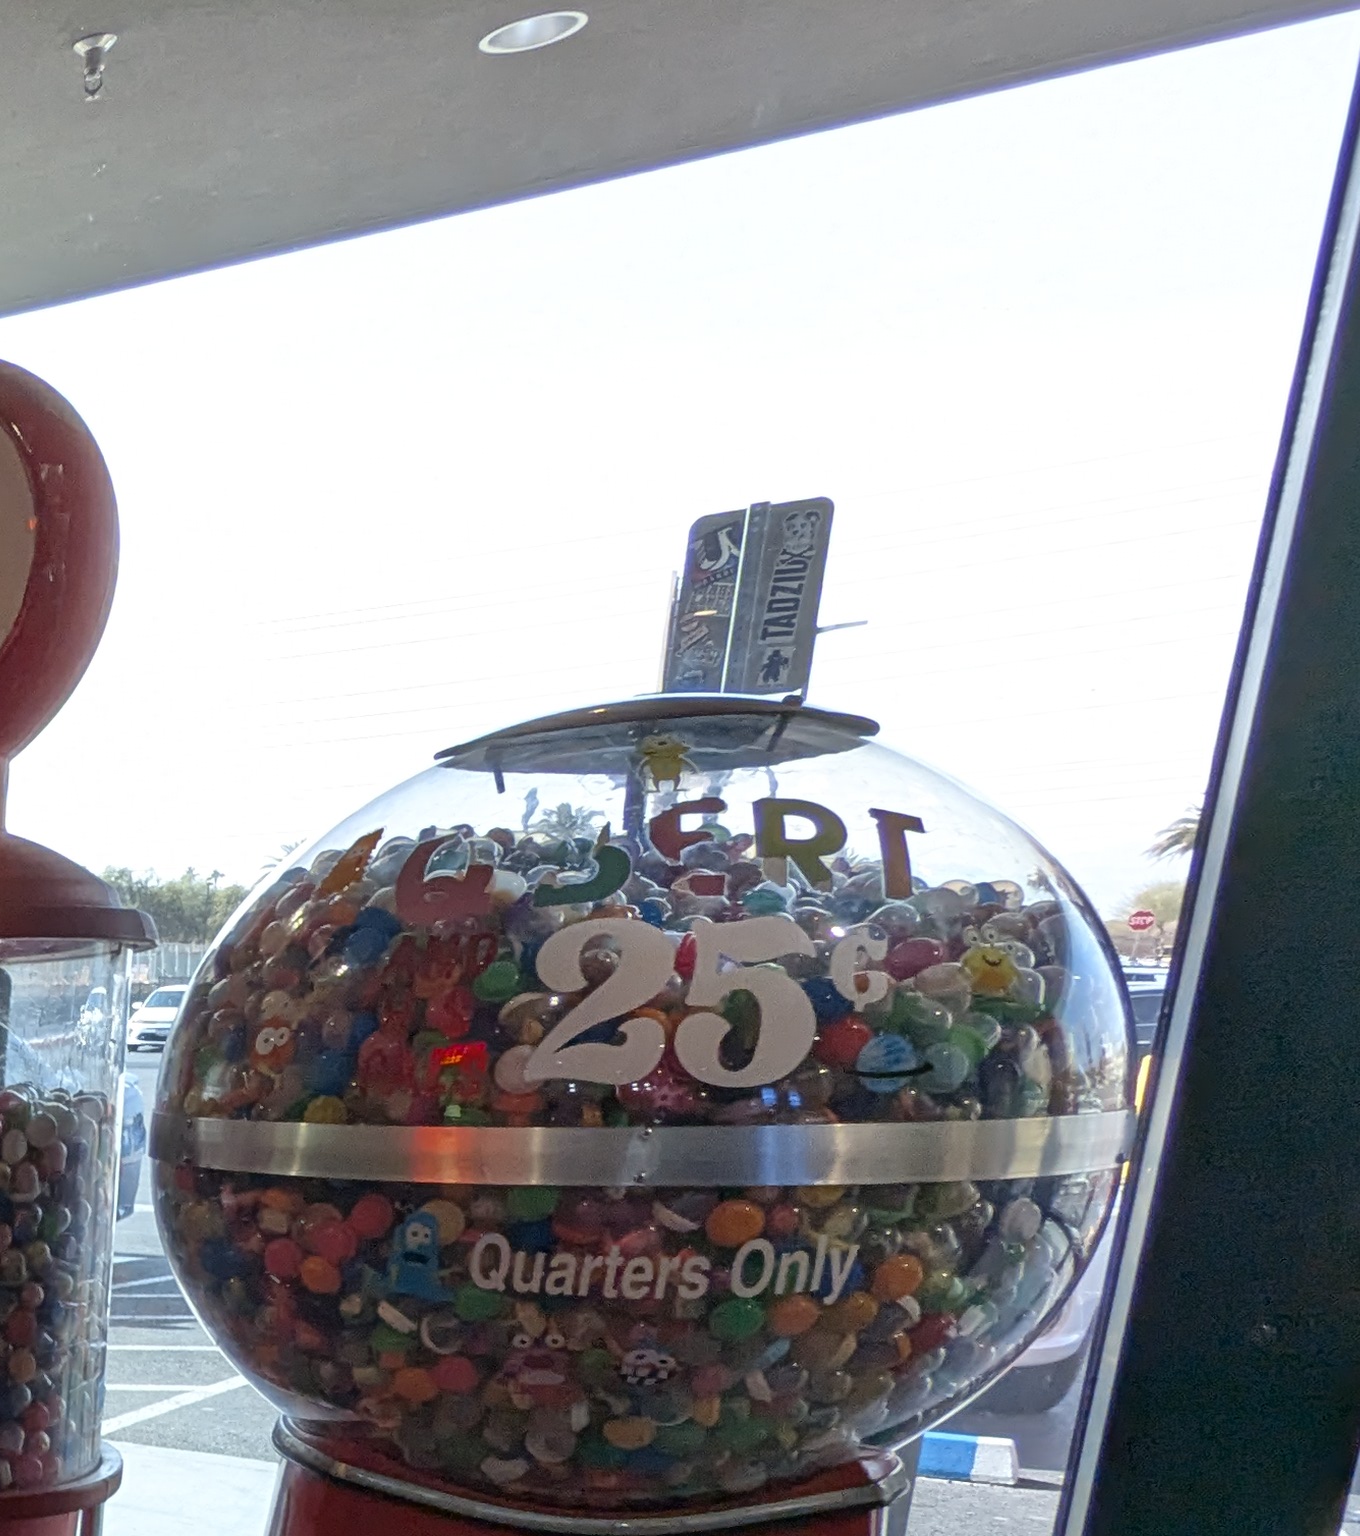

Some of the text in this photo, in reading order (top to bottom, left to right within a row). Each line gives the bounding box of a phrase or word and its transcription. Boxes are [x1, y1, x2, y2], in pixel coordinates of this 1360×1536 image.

[1130, 916, 1154, 926] STOP
[523, 917, 889, 1089] 25¢
[470, 1233, 859, 1306] Quarters Only
